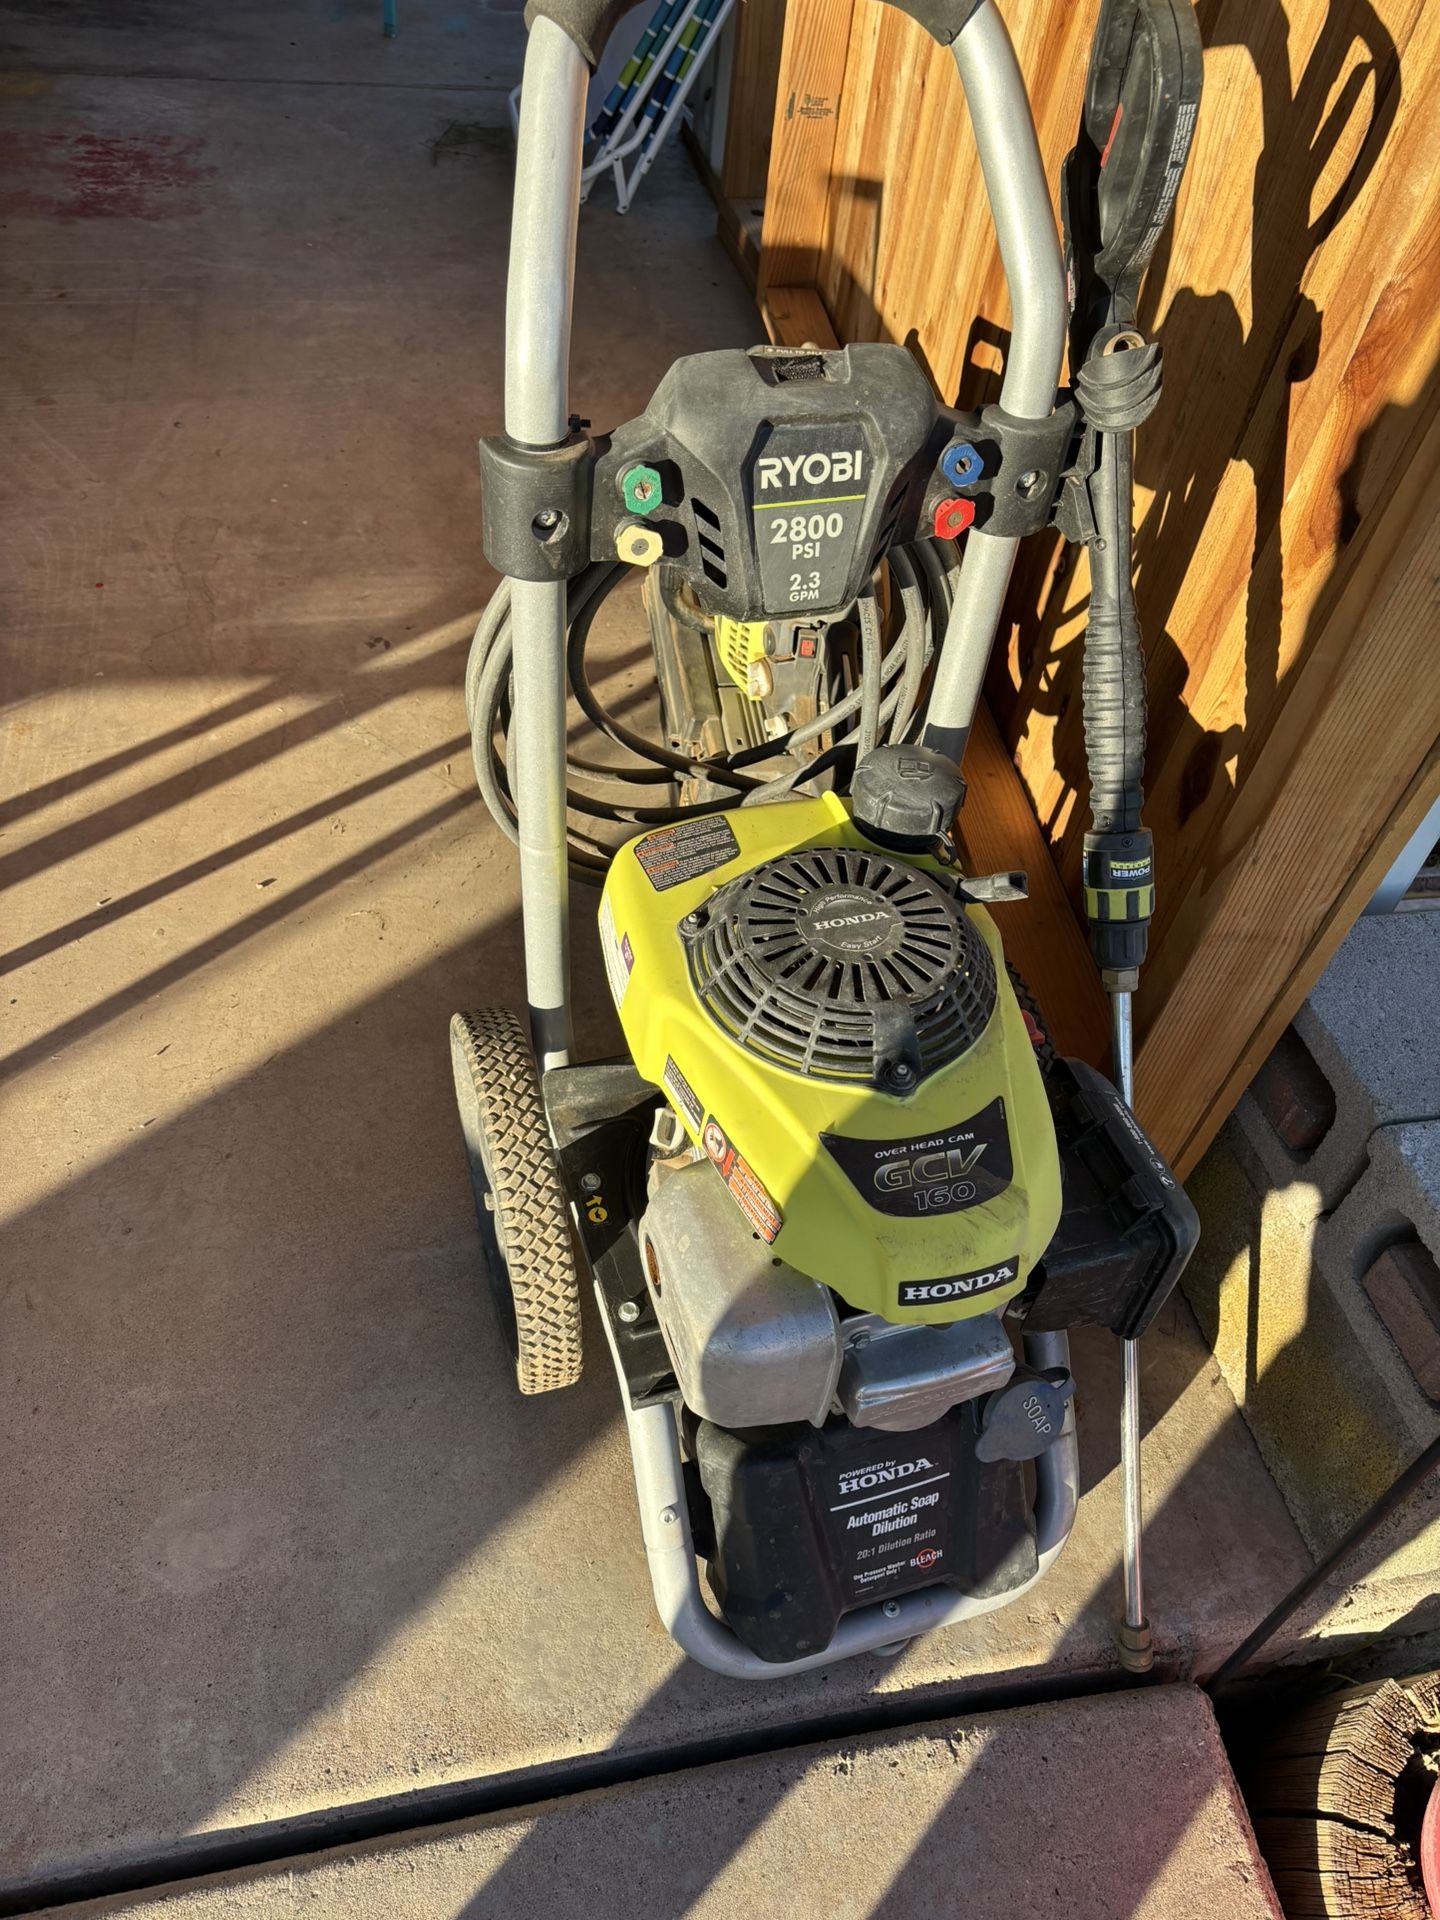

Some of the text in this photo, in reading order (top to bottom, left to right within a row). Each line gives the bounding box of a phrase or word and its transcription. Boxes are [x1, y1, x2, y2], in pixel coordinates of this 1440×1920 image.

[758, 450, 862, 489] RYOBI
[770, 512, 844, 544] 2800
[792, 542, 820, 560] PSI
[789, 572, 820, 592] 2.3
[789, 590, 820, 602] GPM
[1112, 866, 1150, 878] POWER
[813, 894, 873, 914] High Performance
[812, 911, 892, 930] HONDA
[840, 935, 882, 950] Easy Start
[874, 1132, 975, 1160] OVER HEAD CAM
[873, 1143, 988, 1193] GCV
[914, 1181, 976, 1211] 160
[904, 1266, 1014, 1300] HONDA
[1022, 1396, 1052, 1434] SOAP
[838, 1460, 896, 1481] POWERED by
[838, 1458, 934, 1495] HONDA
[846, 1492, 940, 1530] Automatic Soap
[872, 1514, 918, 1537] Dilution
[856, 1528, 936, 1561] 20:1 Dilution Ratio
[910, 1550, 943, 1567] BLEACH
